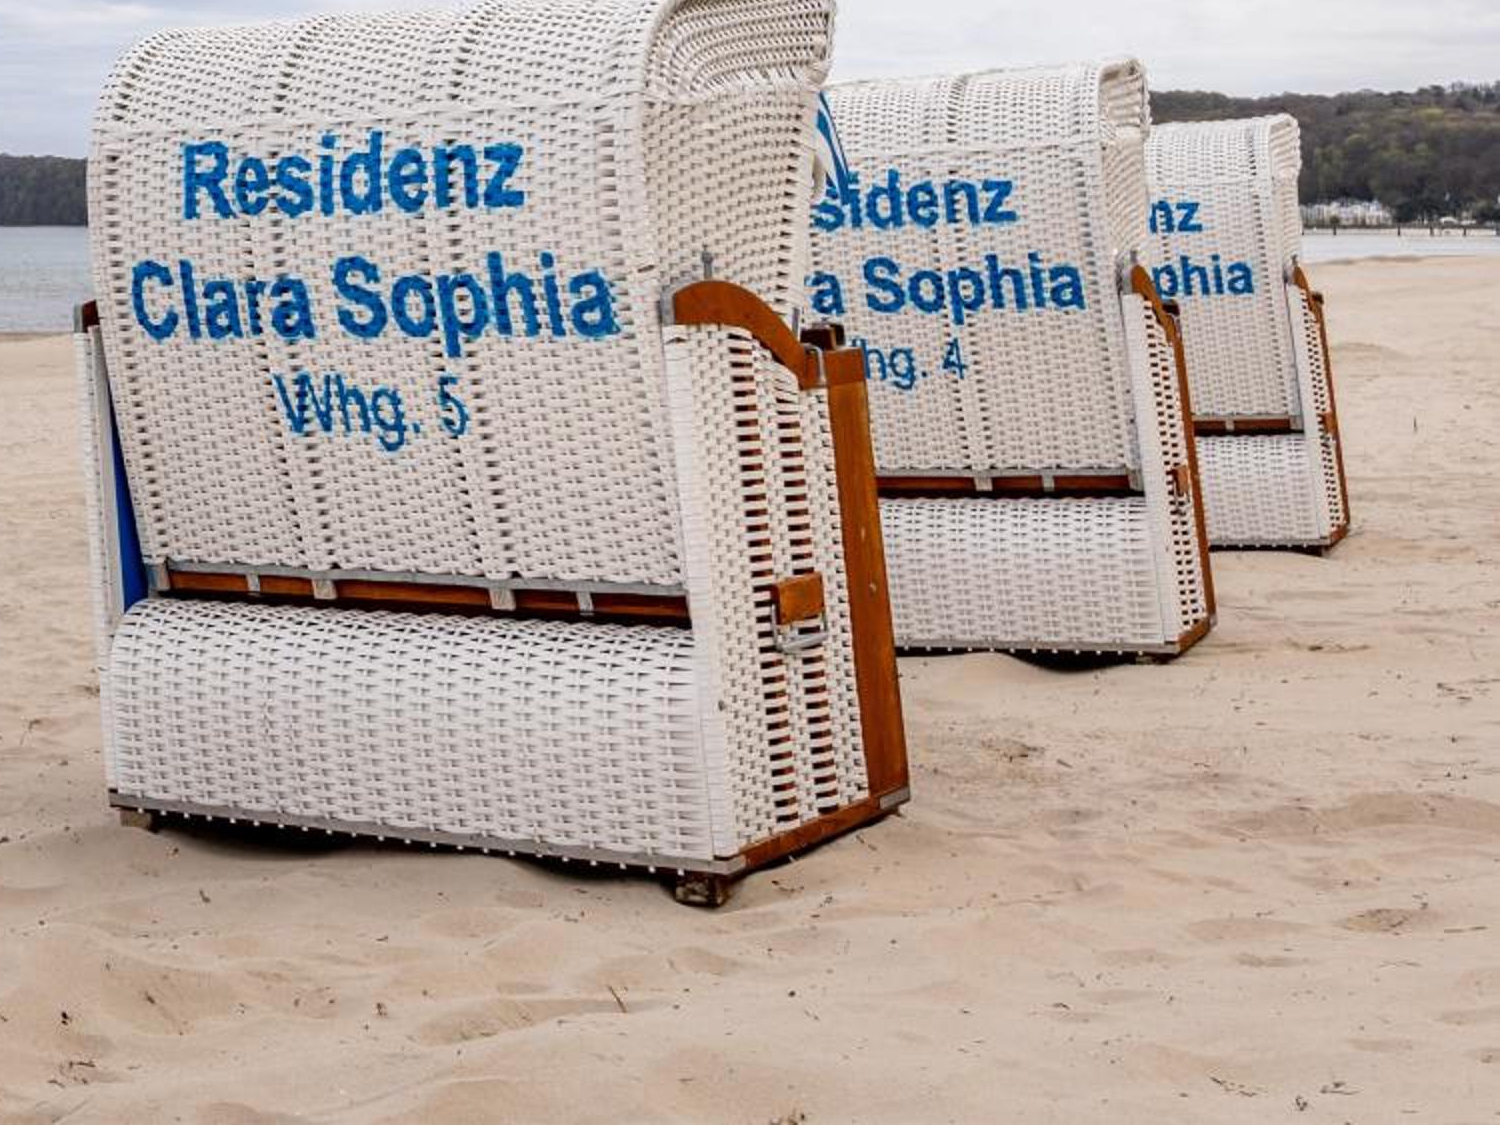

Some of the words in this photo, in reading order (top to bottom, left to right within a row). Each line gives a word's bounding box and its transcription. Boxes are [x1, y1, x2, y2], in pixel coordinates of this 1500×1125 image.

[182, 129, 527, 221] Residenz
[810, 165, 1019, 233] sidenz
[131, 259, 319, 345] Clara
[331, 251, 622, 359] Sophia
[862, 251, 1088, 327] Sophia
[1151, 254, 1255, 301] phia
[851, 337, 928, 392] hg.
[941, 337, 970, 381] 4
[273, 373, 423, 455] Whg.
[438, 375, 472, 441] 5
